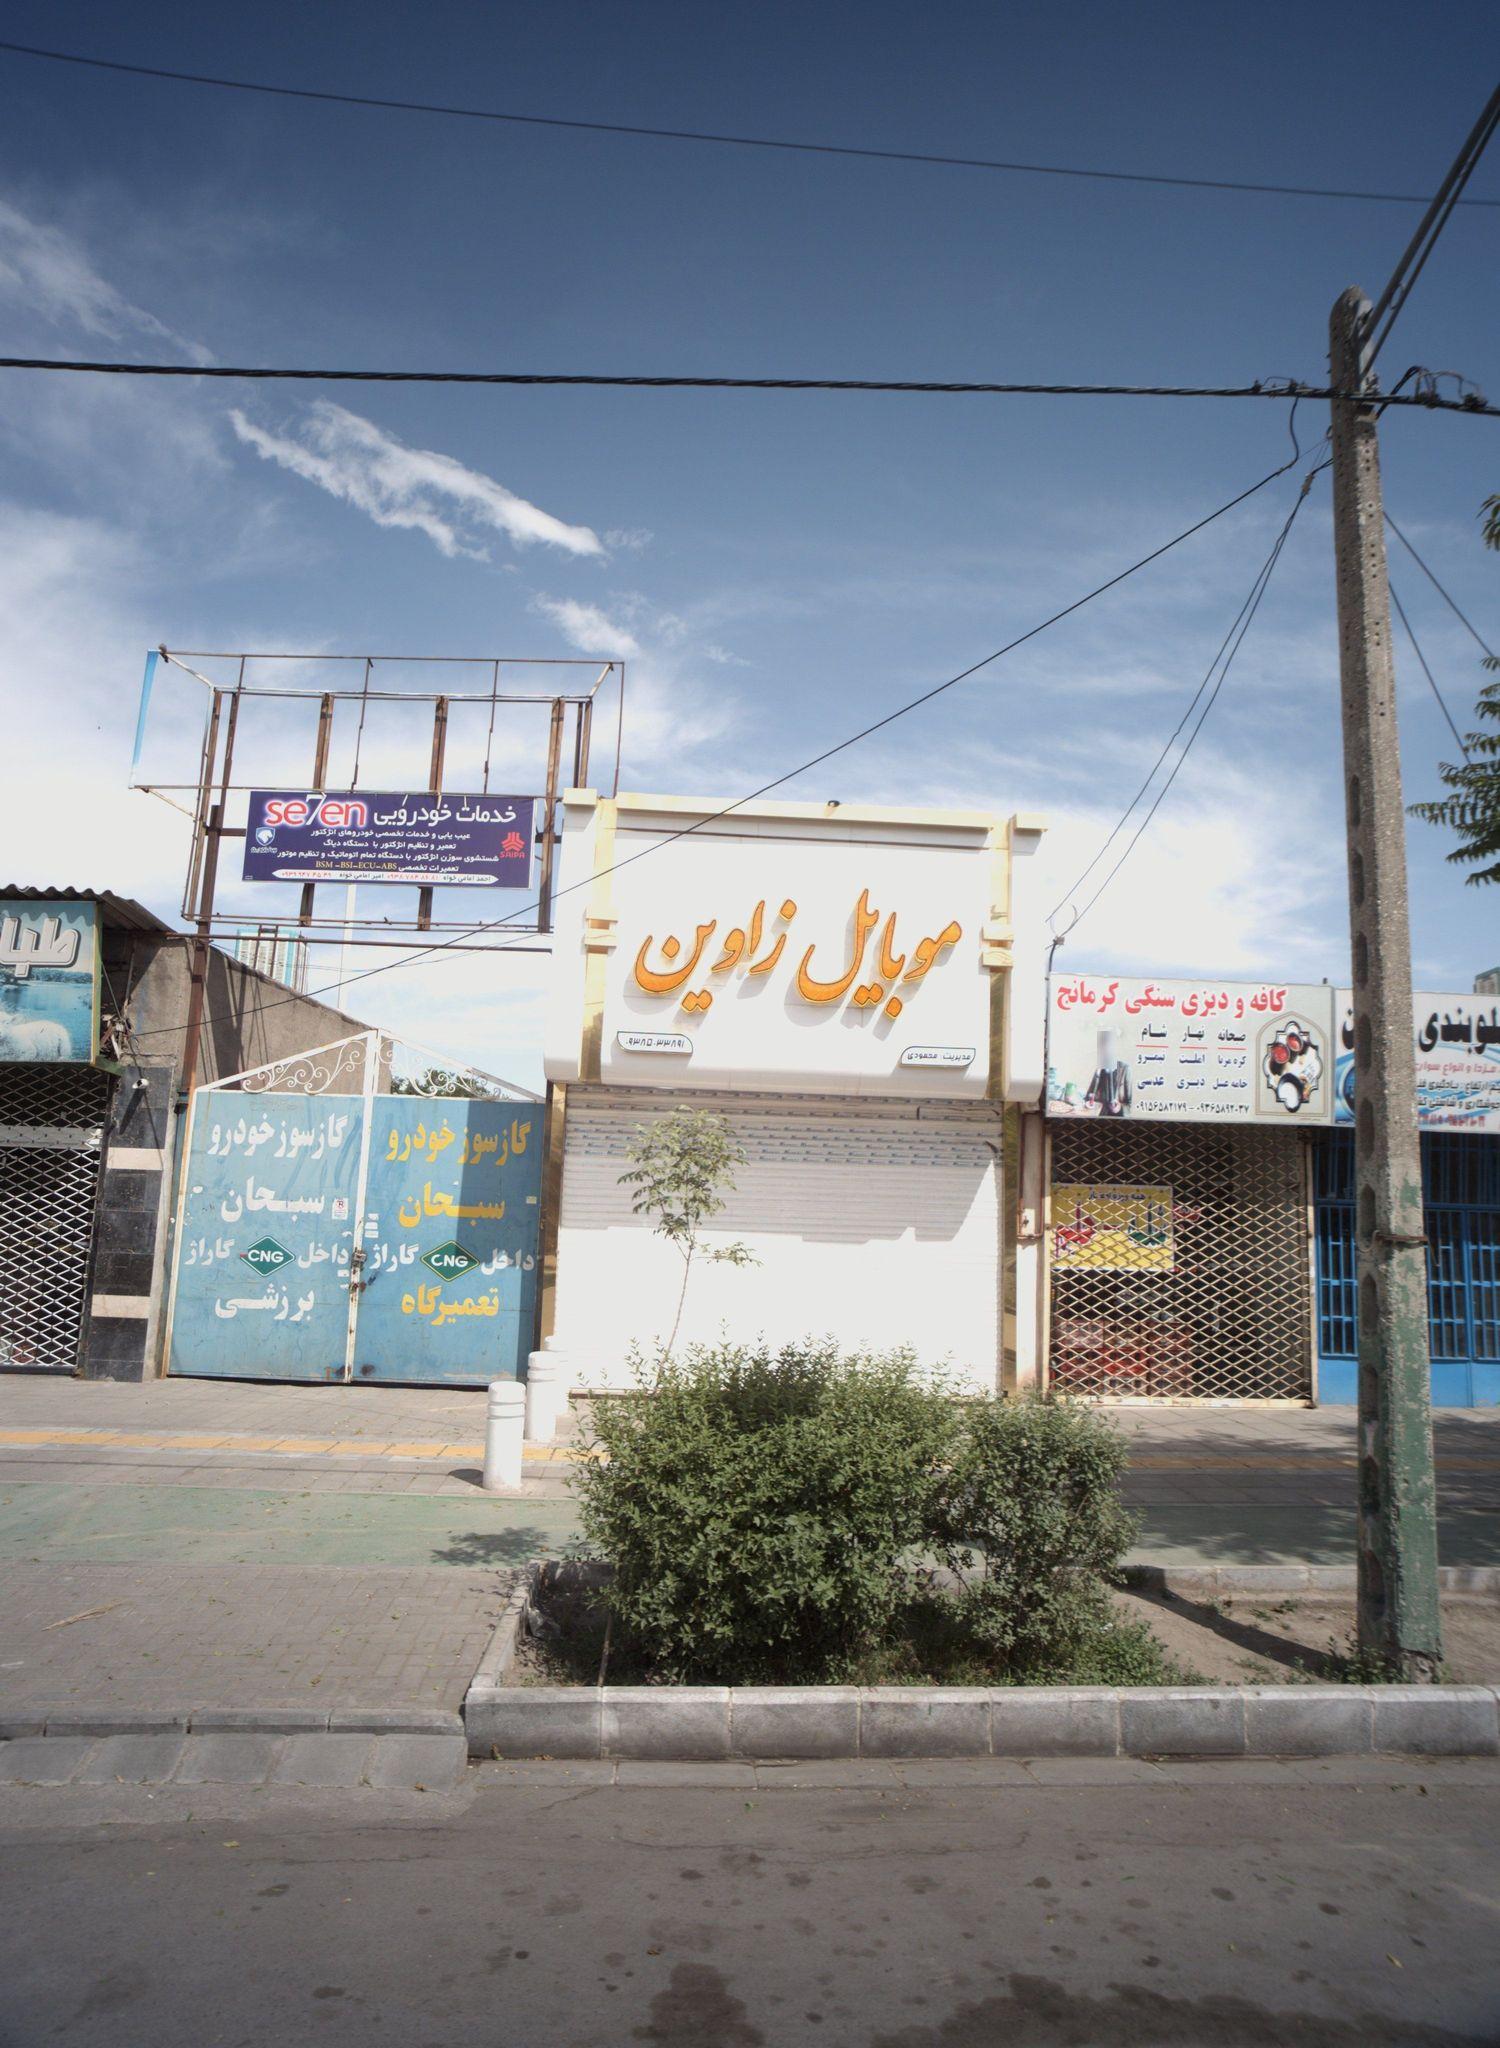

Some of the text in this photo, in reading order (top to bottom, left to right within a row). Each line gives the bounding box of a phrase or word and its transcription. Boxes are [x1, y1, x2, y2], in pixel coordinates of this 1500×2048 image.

[265, 792, 366, 826] se7en
[456, 804, 517, 823] خدمات
[310, 828, 337, 839] انژکتور
[338, 829, 374, 840] خودروهای
[375, 829, 405, 841] تخصصی
[405, 830, 430, 840] خدمات
[455, 832, 471, 841] عیب
[323, 840, 341, 848] دیاگ
[342, 841, 369, 849] دستگاه
[372, 841, 379, 850] با
[380, 841, 406, 852] انژکتور
[407, 842, 429, 851] تنظیم
[436, 843, 457, 852] تعمیر
[277, 850, 297, 860] موتور
[298, 849, 320, 860] تنظیم
[327, 850, 360, 861] اتوماتیک
[360, 851, 376, 861] تمام
[378, 851, 404, 860] دستگاه
[405, 853, 411, 861] با
[412, 853, 439, 863] انژکتور
[440, 854, 462, 863] سوزن
[463, 853, 500, 863] شستشوی
[500, 852, 526, 860] SAIPA
[315, 861, 333, 869] BSM
[398, 863, 428, 873] تخصصی
[428, 864, 460, 873] تعمیرات
[634, 888, 962, 1018] موبایل زاوین
[1057, 980, 1287, 1019] کافه و دیزی سنگی کرمانج
[1141, 1023, 1167, 1041] شام
[1182, 1025, 1205, 1042] نهار
[943, 1052, 971, 1062] مدیریت
[1137, 1077, 1165, 1090] عدسی
[207, 1113, 275, 1156] خودرو
[385, 1118, 456, 1163] خودرو
[221, 1176, 325, 1222] سبحان
[398, 1181, 506, 1228] سبحان
[184, 1237, 350, 1269] داخل گاراژ
[247, 1249, 285, 1264] CNG
[369, 1243, 535, 1276] داخل گاراژ
[430, 1254, 470, 1268] CNG
[401, 1282, 500, 1326] تعمیرگاه
